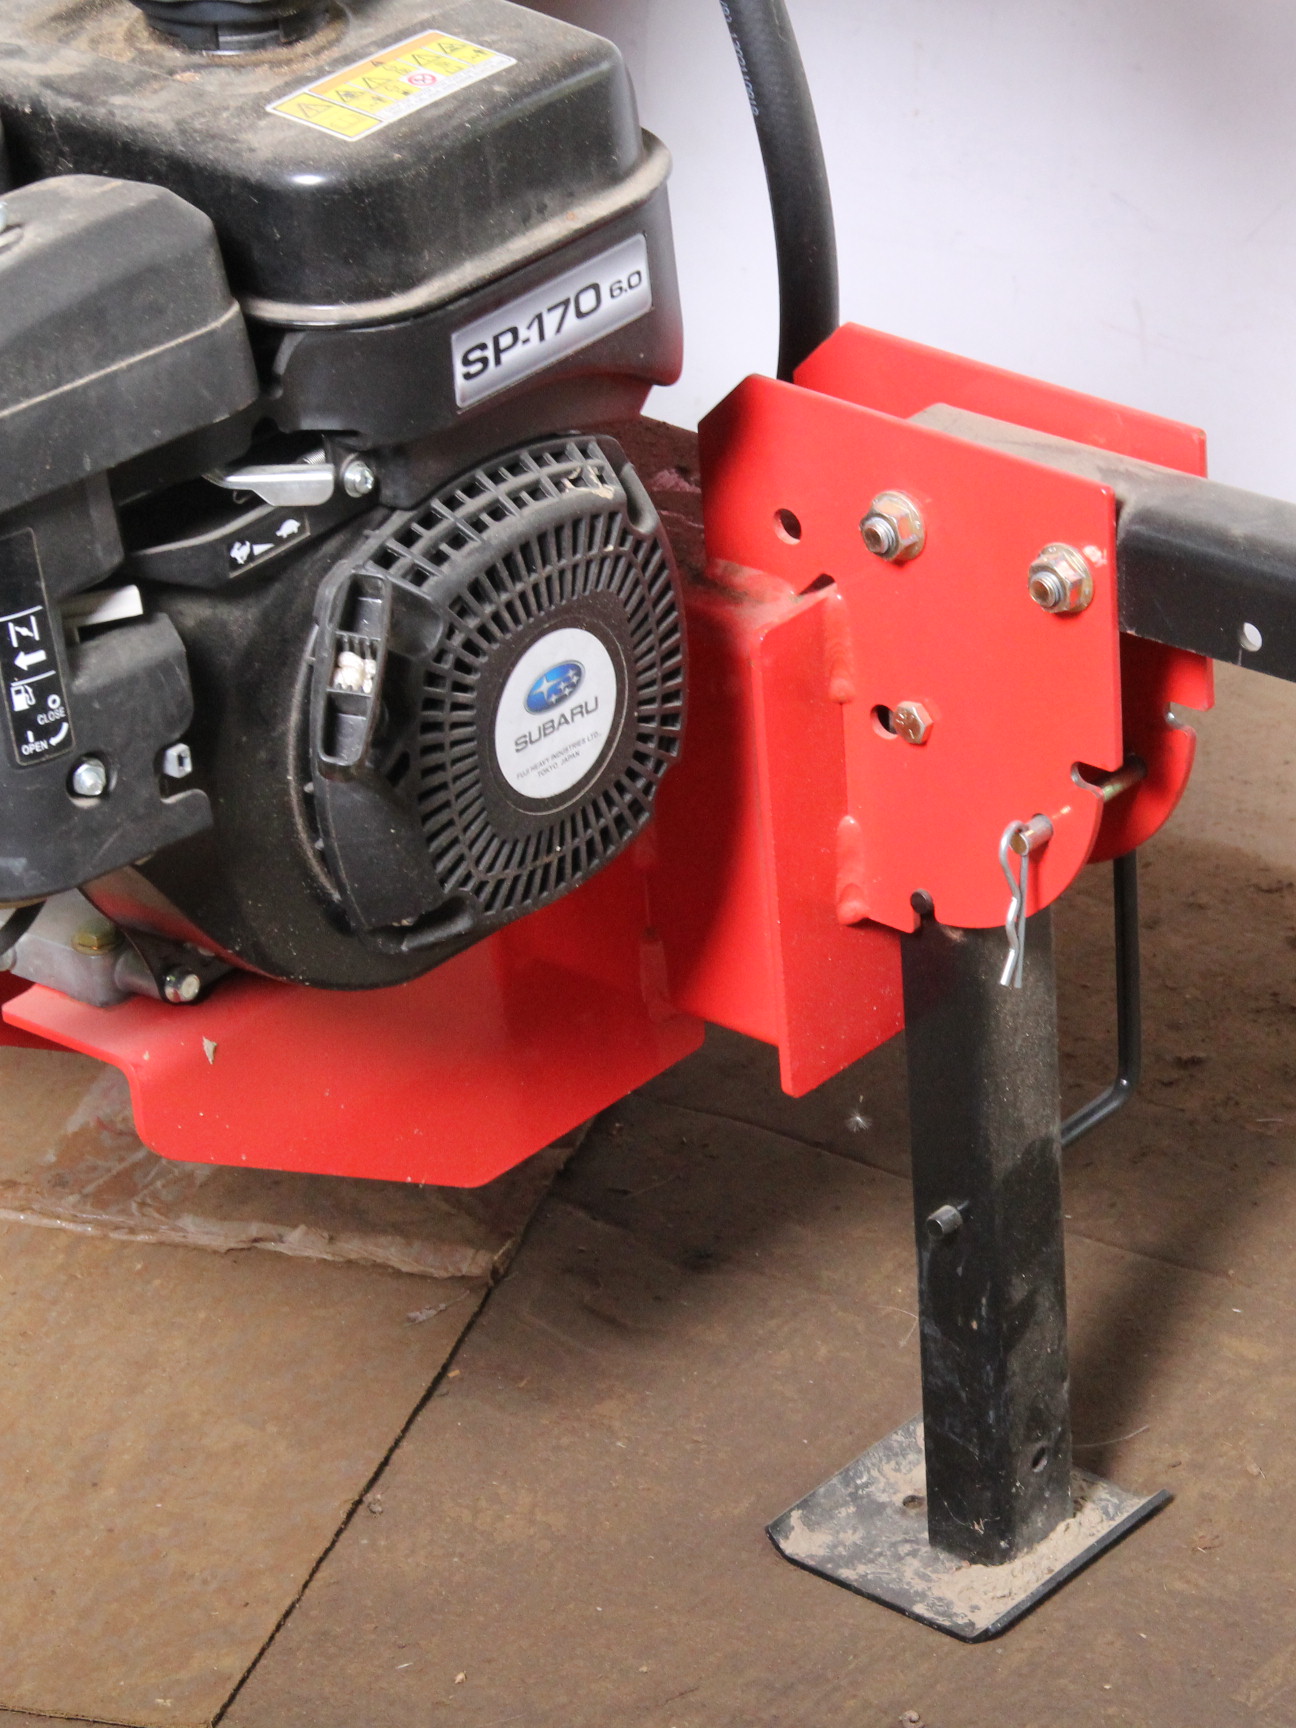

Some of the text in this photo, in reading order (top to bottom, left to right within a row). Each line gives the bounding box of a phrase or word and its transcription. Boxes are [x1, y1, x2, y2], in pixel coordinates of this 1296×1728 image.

[461, 270, 642, 382] SP-170 6.0
[37, 706, 66, 725] CLOSE
[514, 696, 599, 753] SUBARU
[21, 739, 49, 756] OPEN
